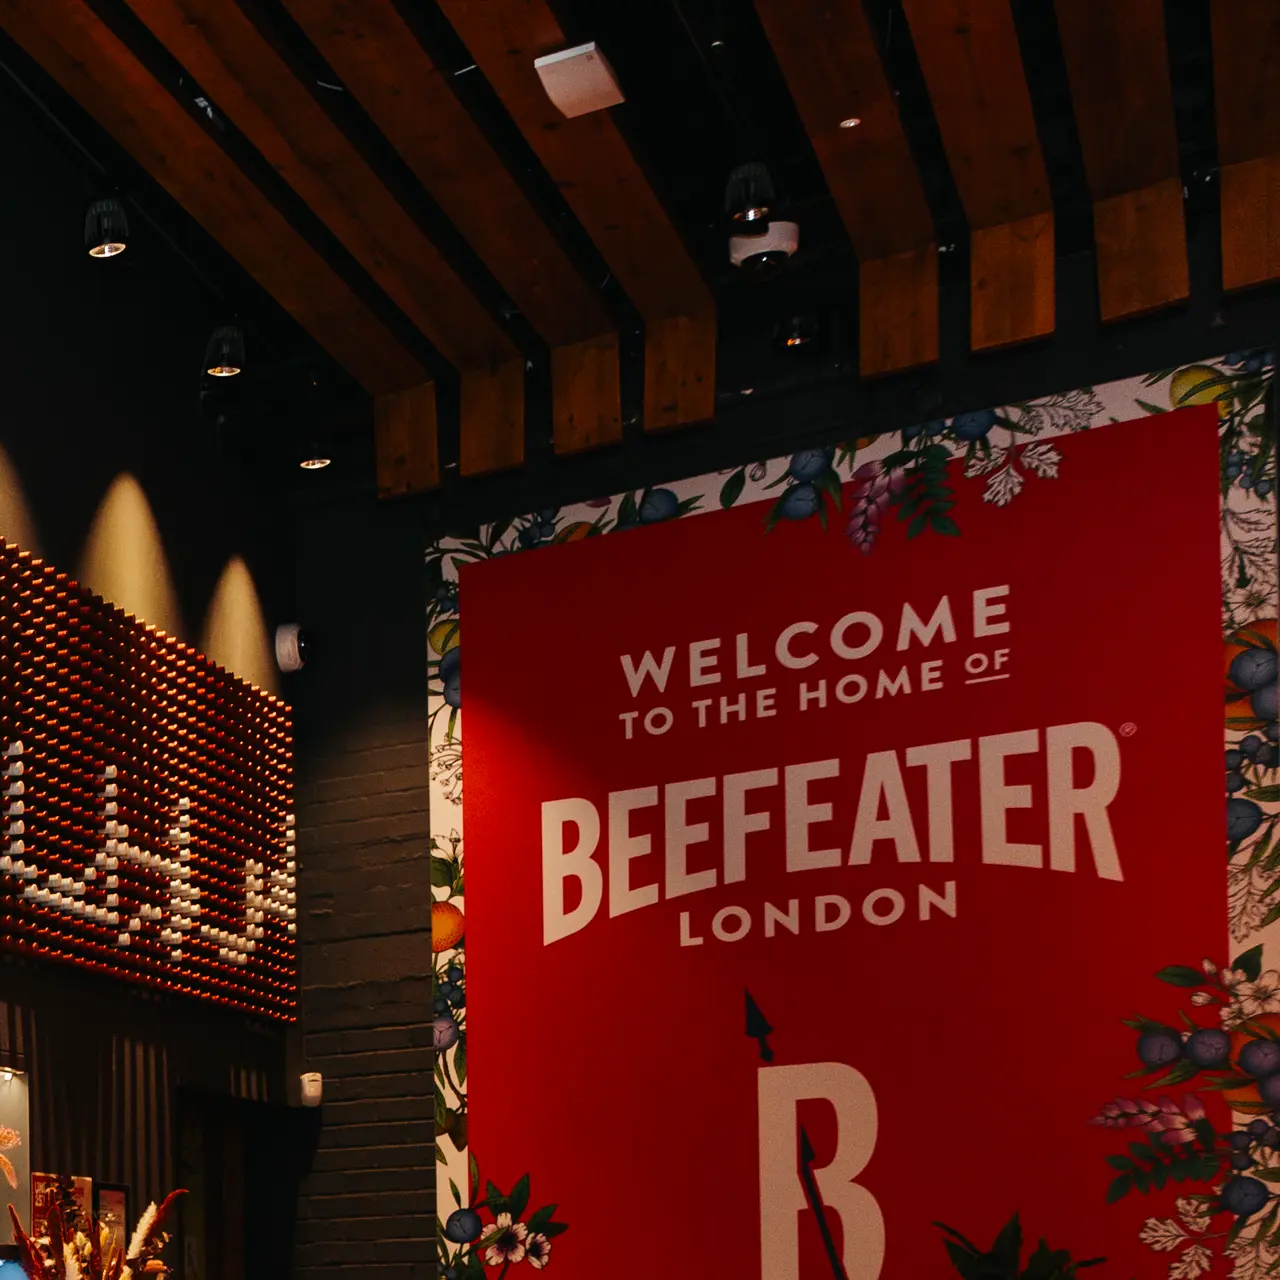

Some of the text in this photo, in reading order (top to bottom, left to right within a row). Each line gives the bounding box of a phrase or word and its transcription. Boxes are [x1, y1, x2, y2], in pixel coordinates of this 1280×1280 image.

[620, 585, 1009, 697] WELCOME
[619, 649, 1009, 739] TO THE HOME OF
[541, 722, 1123, 946] BEEFEATER
[680, 881, 956, 946] LONDON
